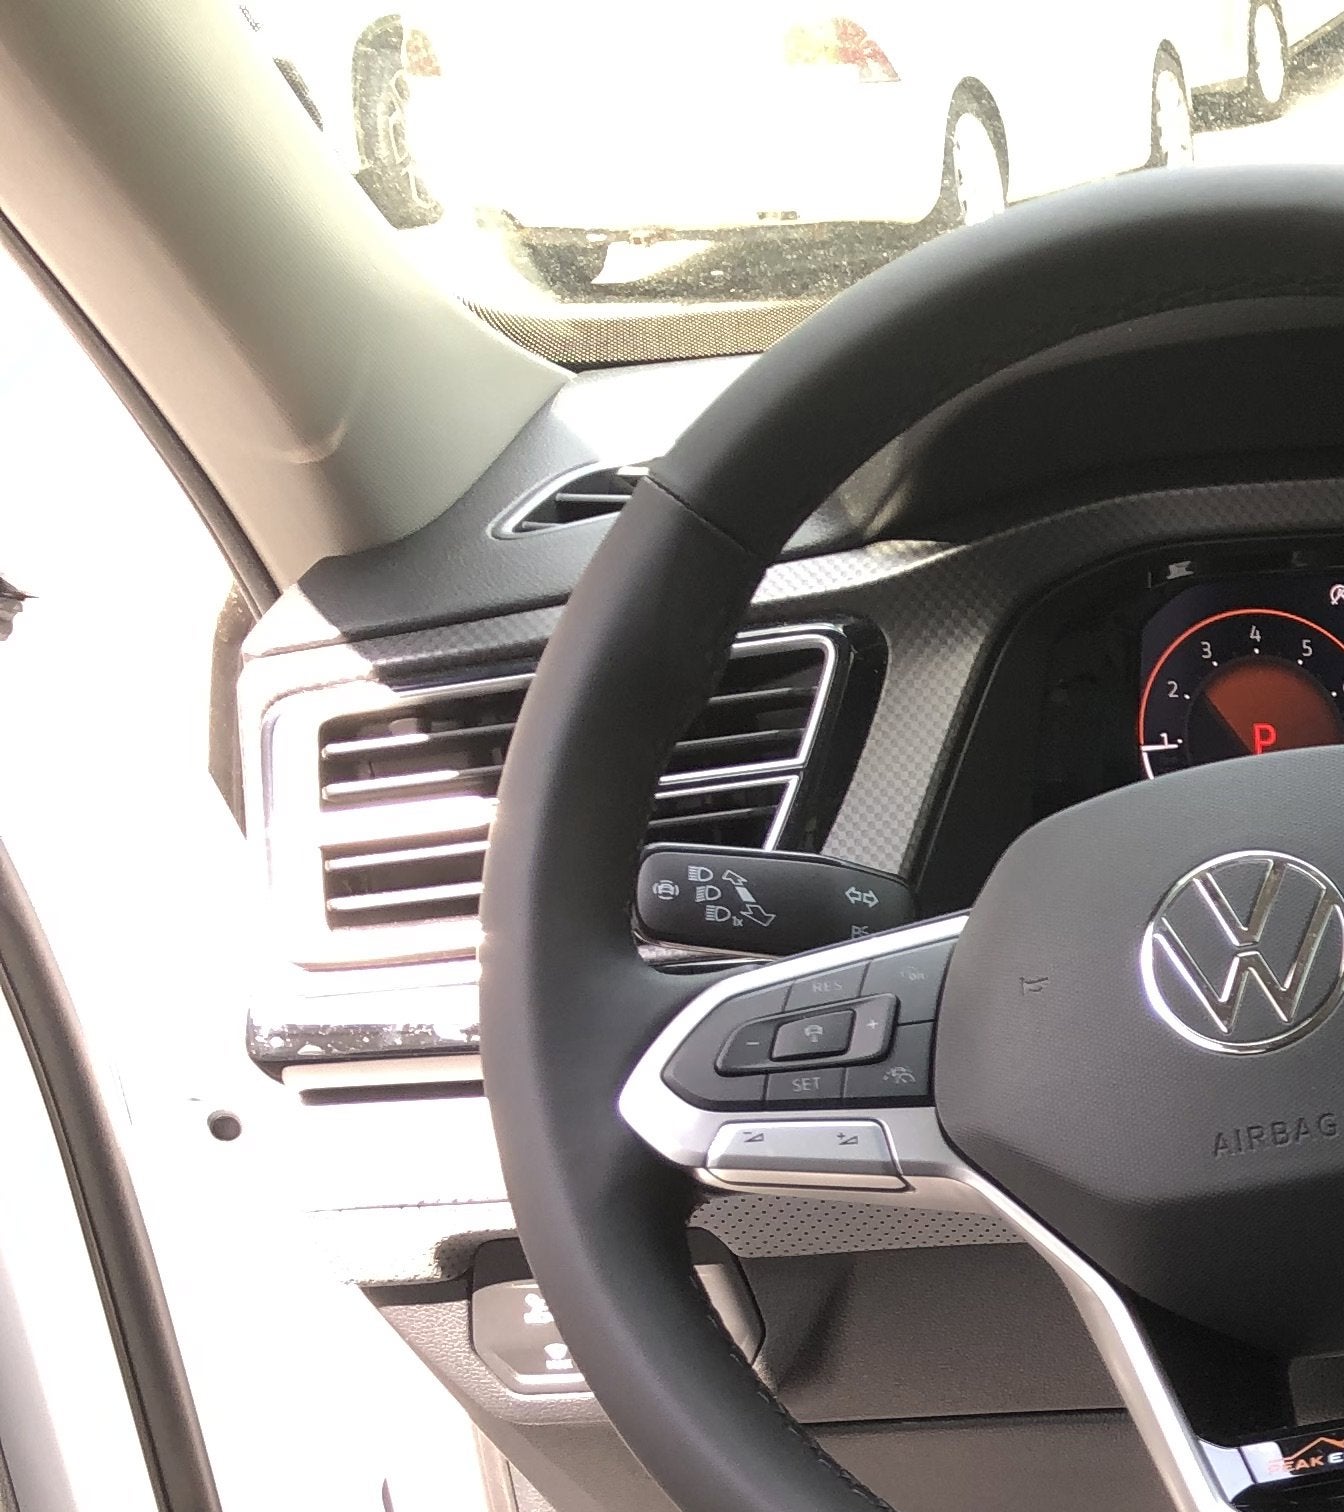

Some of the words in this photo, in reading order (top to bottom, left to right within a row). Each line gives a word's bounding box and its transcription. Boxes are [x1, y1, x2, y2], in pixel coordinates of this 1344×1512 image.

[1250, 625, 1261, 642] 4
[1201, 641, 1212, 659] 3
[1302, 640, 1313, 657] 5
[1168, 681, 1179, 698] 2
[1160, 733, 1169, 747] 1
[1253, 722, 1277, 755] P
[812, 981, 843, 993] RES
[792, 1076, 821, 1092] SET
[1213, 1112, 1339, 1158] AIRBAG
